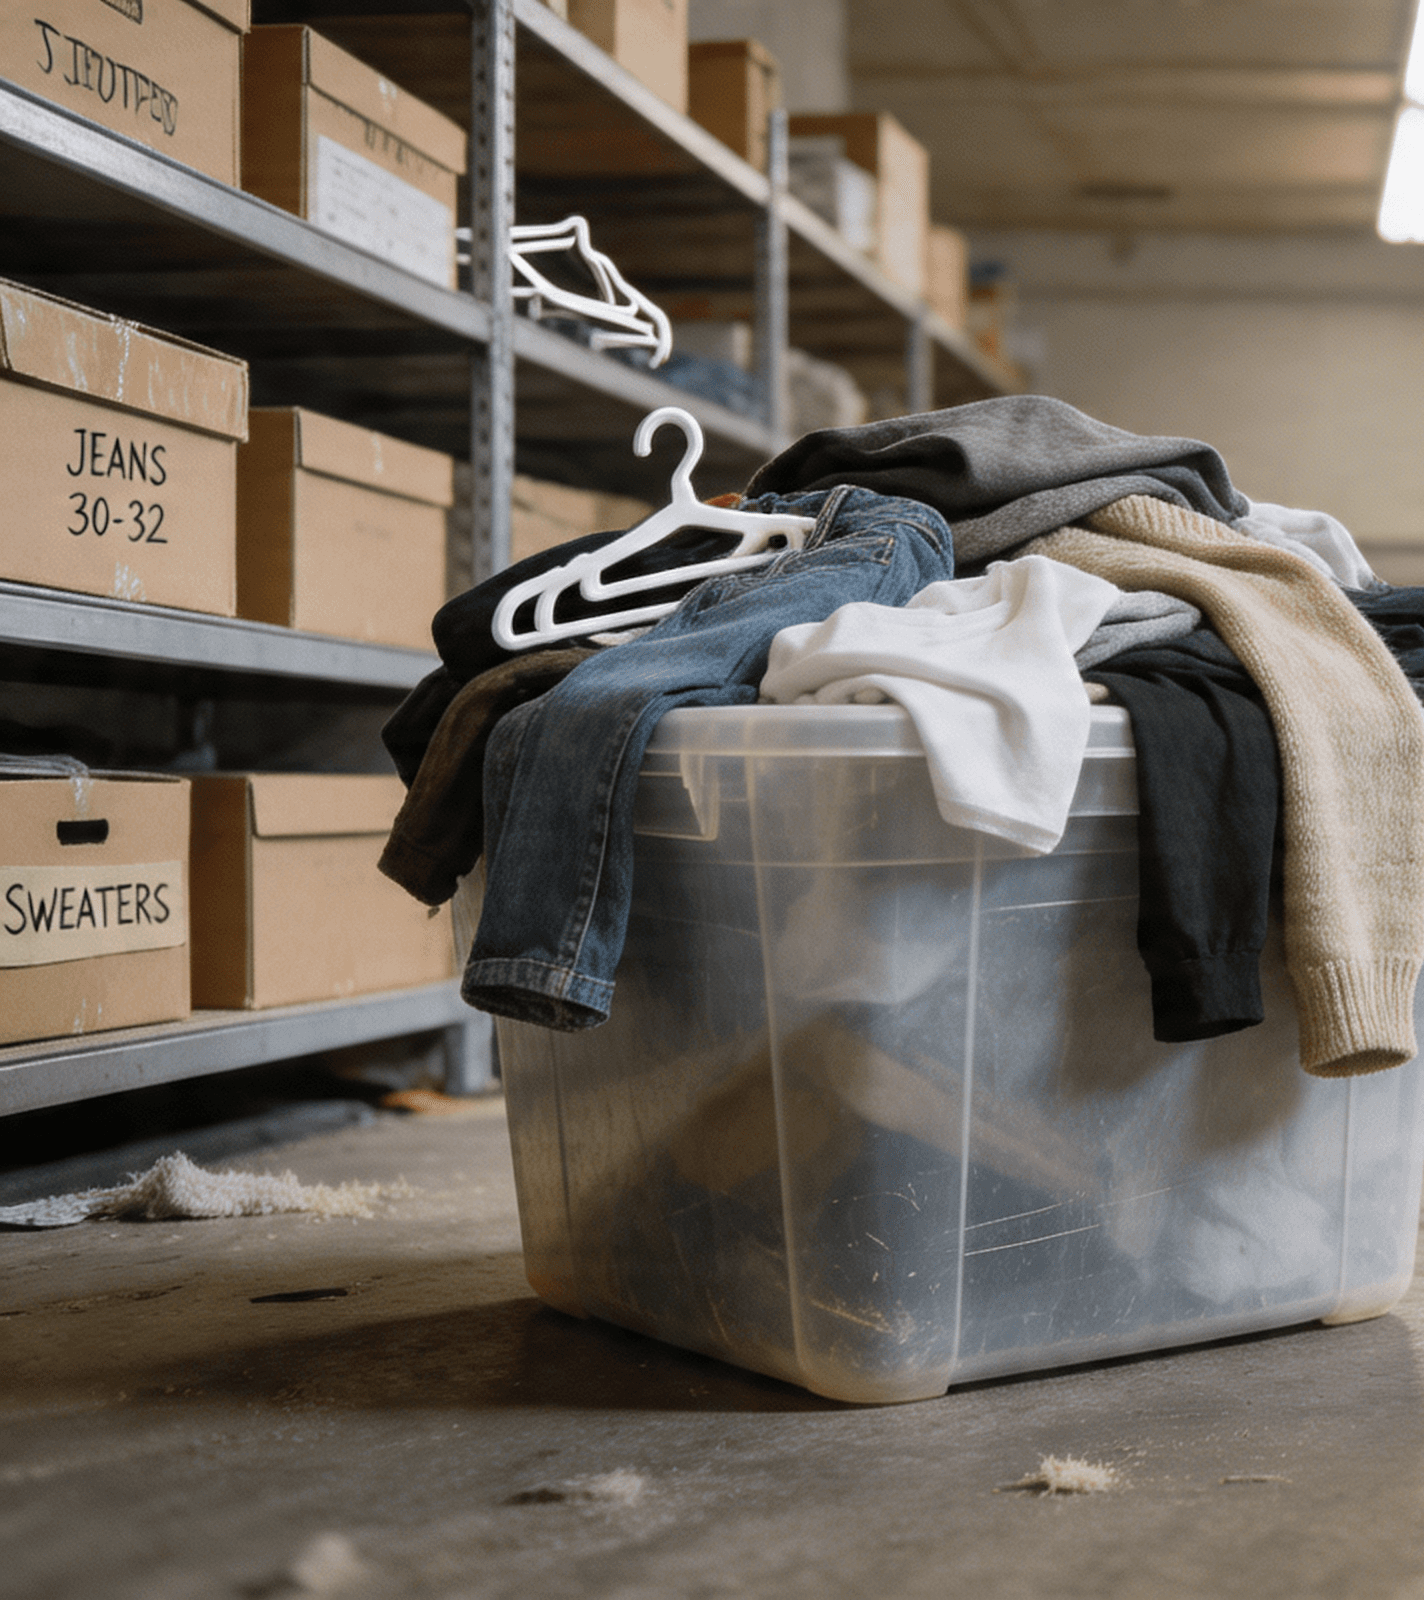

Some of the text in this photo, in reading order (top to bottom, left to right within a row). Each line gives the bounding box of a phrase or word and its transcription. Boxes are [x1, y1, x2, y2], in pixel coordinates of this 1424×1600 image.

[66, 428, 167, 486] JEANS
[67, 492, 168, 544] 30-32
[4, 883, 170, 935] SWEATERS
